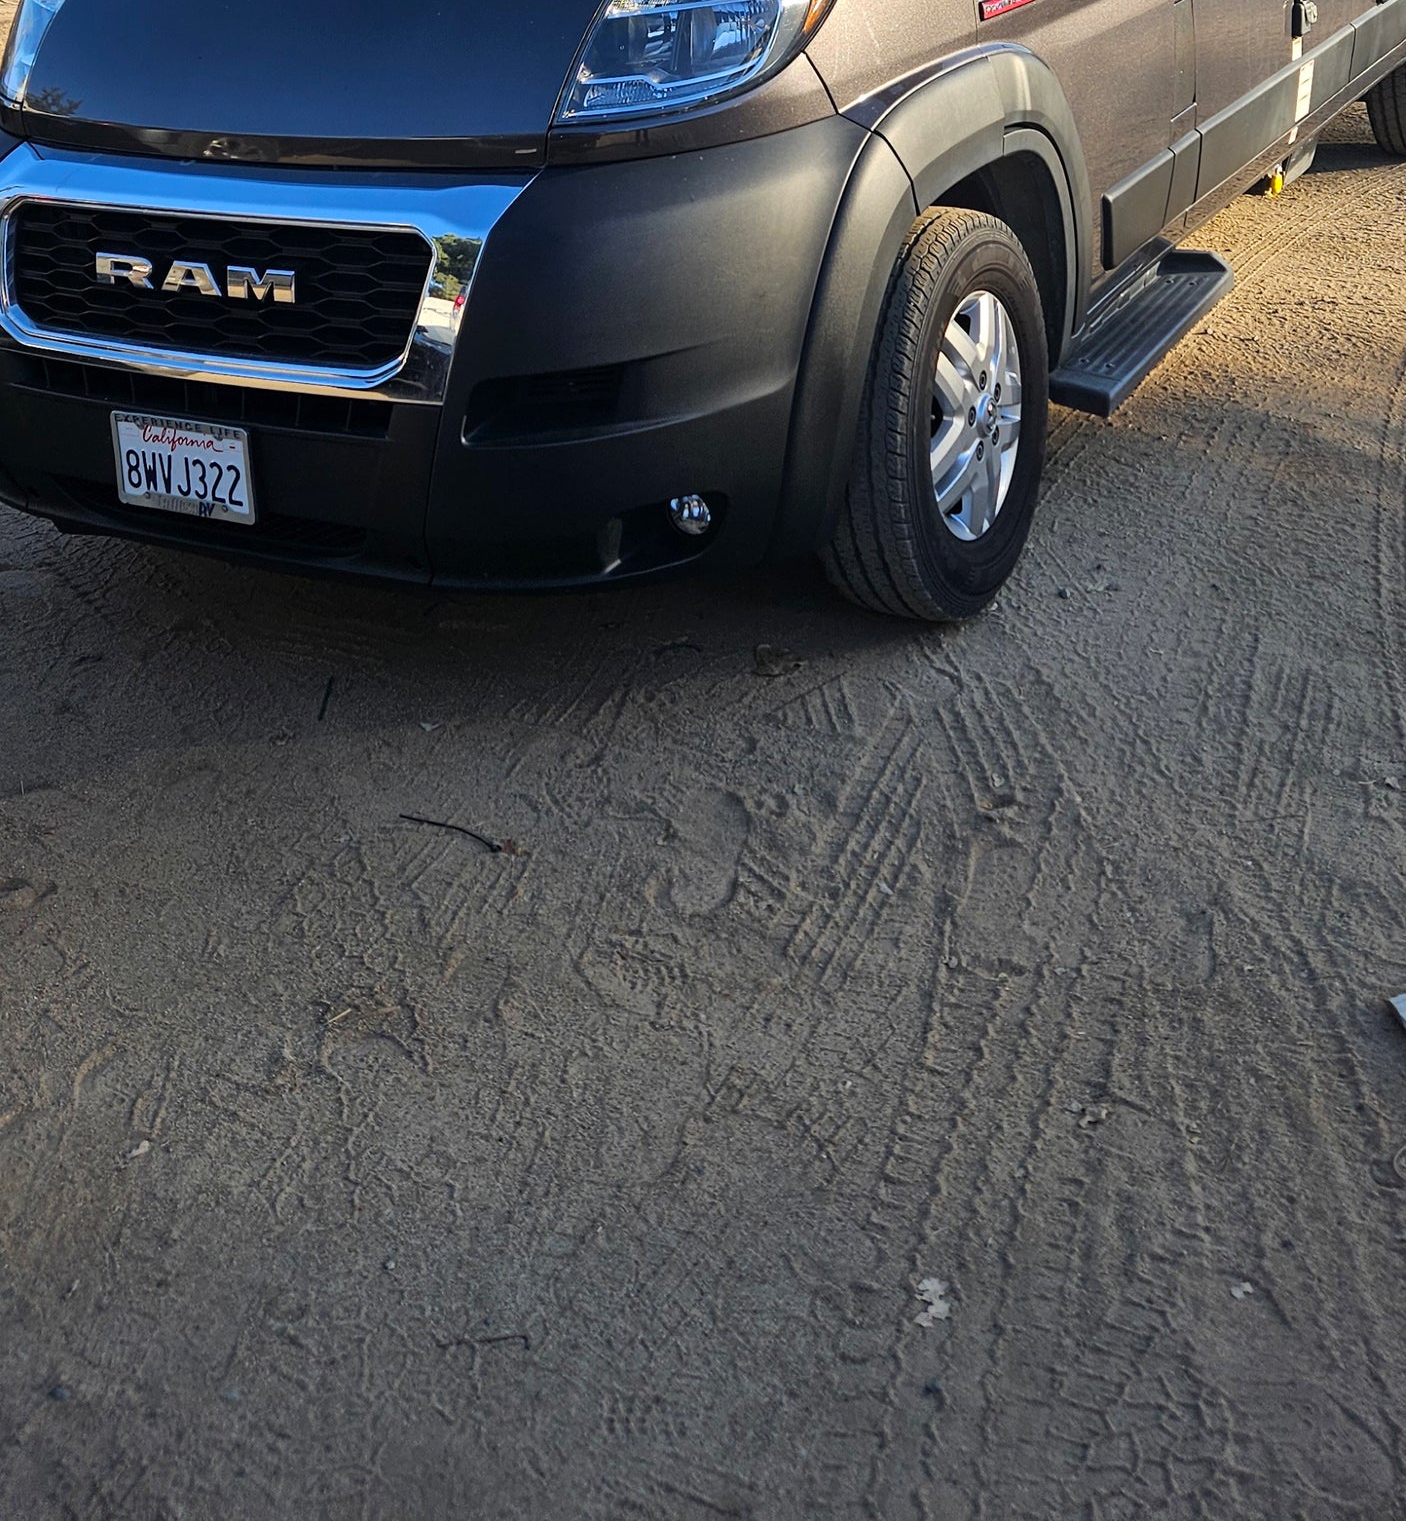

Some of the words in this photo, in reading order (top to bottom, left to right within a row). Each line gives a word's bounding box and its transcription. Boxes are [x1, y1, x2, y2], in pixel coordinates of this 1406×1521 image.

[96, 252, 296, 303] RAM
[114, 413, 203, 432] EXPERIENCE
[209, 425, 241, 439] LIFE
[142, 425, 224, 453] California
[126, 449, 244, 507] 8WVJ322
